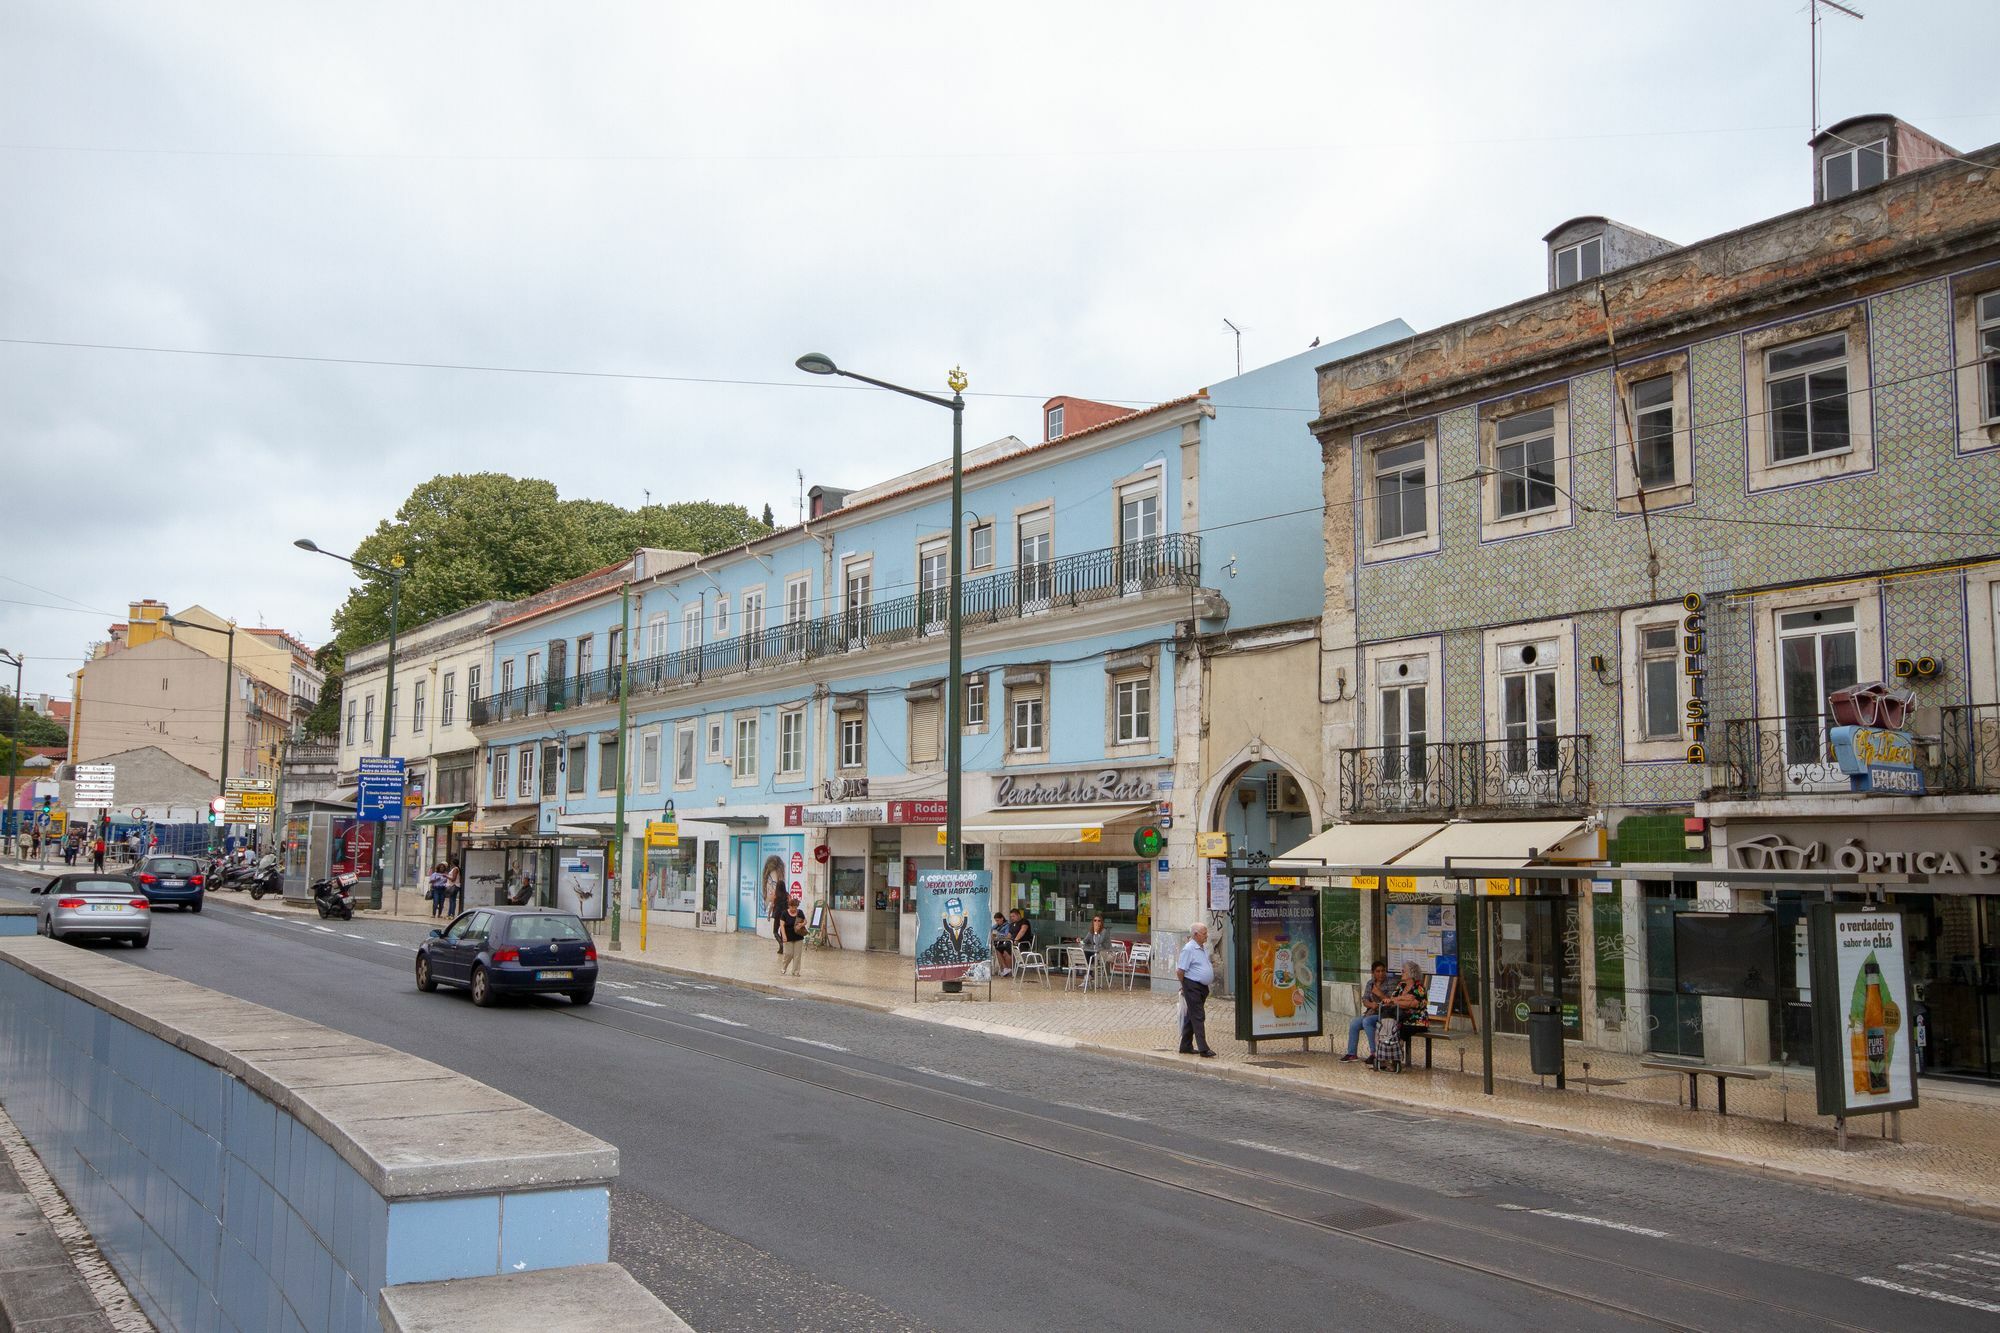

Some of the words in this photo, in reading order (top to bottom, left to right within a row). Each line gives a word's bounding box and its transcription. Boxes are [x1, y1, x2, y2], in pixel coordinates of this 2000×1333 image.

[1896, 657, 1936, 677] DO
[1683, 592, 1706, 764] OCULISTA
[996, 775, 1071, 806] Central
[1069, 776, 1094, 801] do
[1095, 769, 1152, 801] Rato
[1833, 838, 1962, 874] ÓPTICA
[1970, 846, 2000, 874] B
[926, 872, 978, 882] ESPECULAÇÃO
[1354, 876, 1377, 885] Nicola
[1390, 878, 1413, 889] Nicola
[1433, 880, 1439, 888] A
[1490, 880, 1510, 890] Nico
[948, 884, 988, 896] HABITAÇÃO
[1250, 908, 1278, 918] TANGERINA
[1279, 906, 1292, 918] ÁGUA
[1294, 908, 1300, 917] DE
[1300, 908, 1314, 917] COCO
[1840, 922, 1846, 932] o
[1846, 917, 1894, 932] verdadeiro
[1843, 938, 1862, 948] sabor
[1862, 937, 1872, 947] do
[1872, 932, 1893, 948] chá
[1868, 1037, 1884, 1046] PURE
[1868, 1046, 1884, 1056] LEAF
